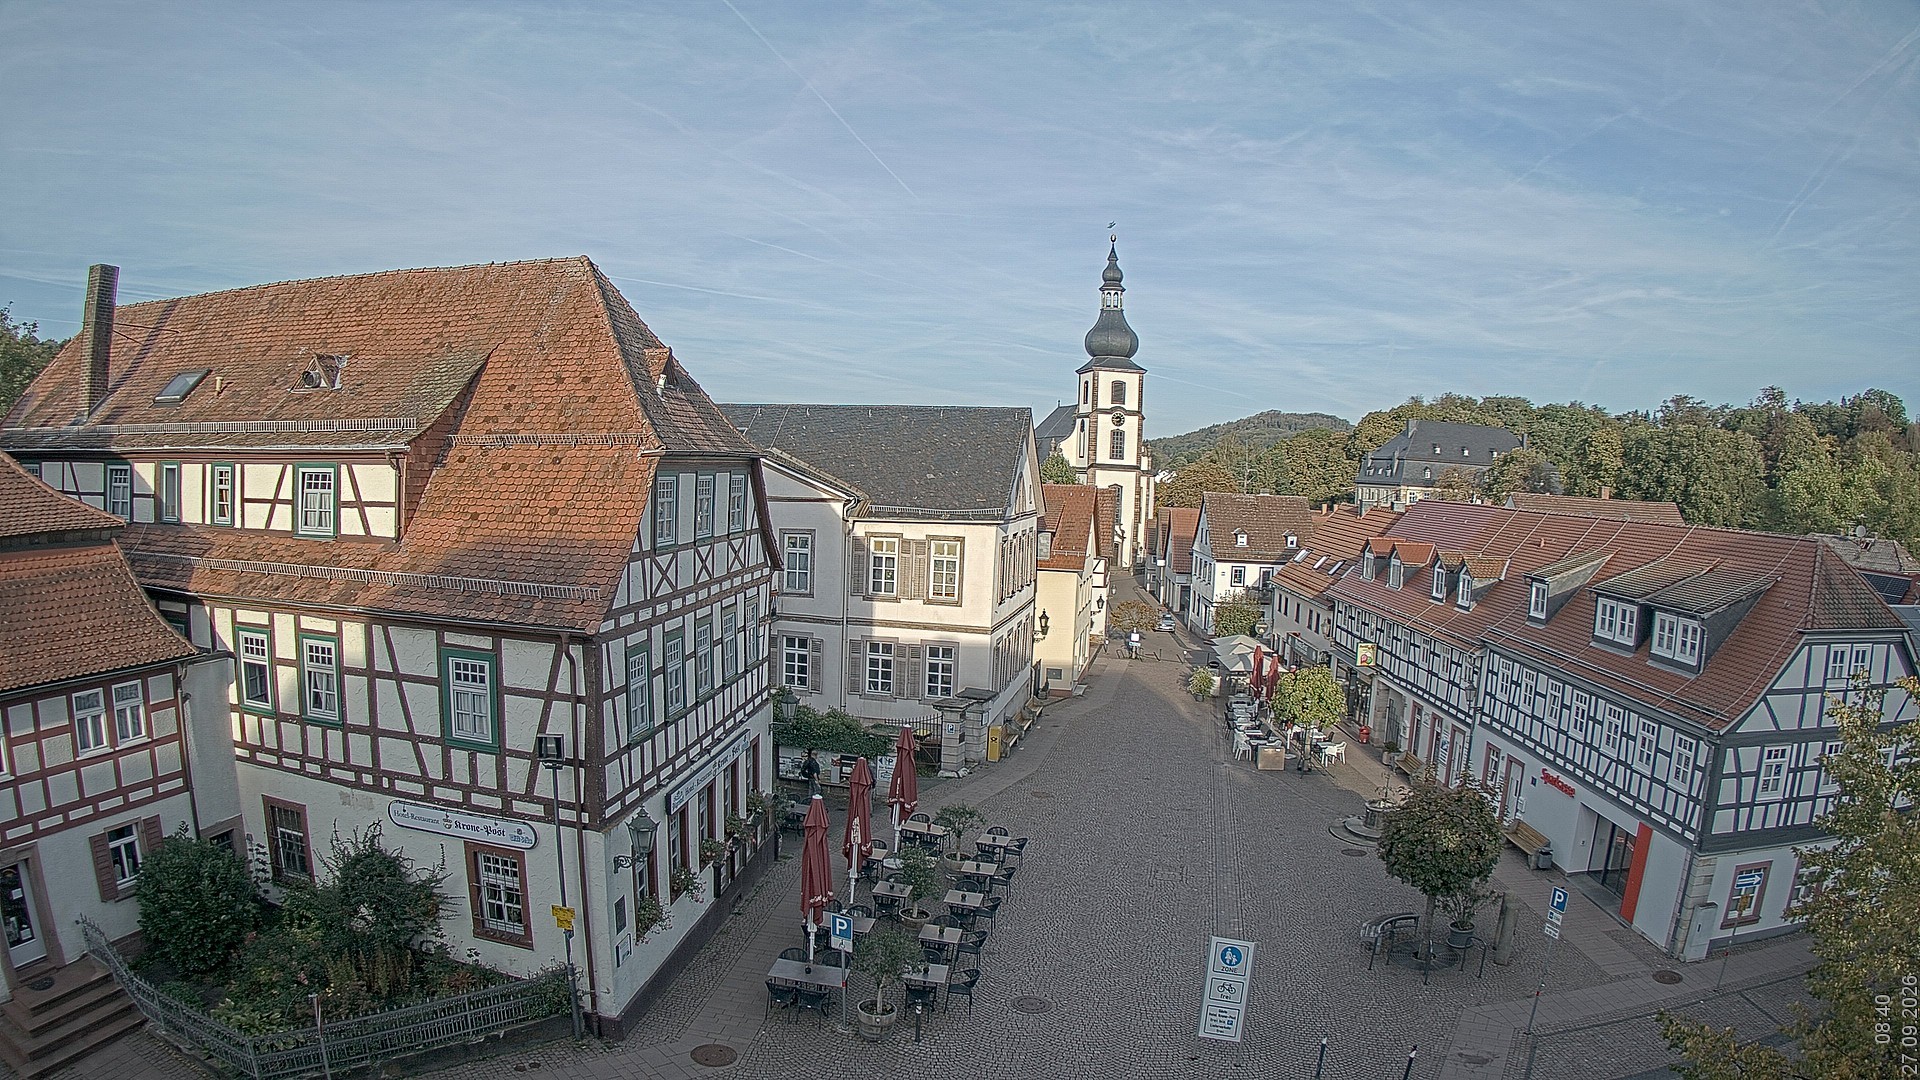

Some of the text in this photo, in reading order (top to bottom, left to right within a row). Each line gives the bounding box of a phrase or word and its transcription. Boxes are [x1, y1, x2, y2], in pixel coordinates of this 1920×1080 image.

[1540, 768, 1576, 798] Sparkasse
[394, 810, 440, 824] Hotel-Restaurant
[454, 820, 506, 837] Krone-Post
[1554, 890, 1564, 907] P
[836, 918, 848, 934] P
